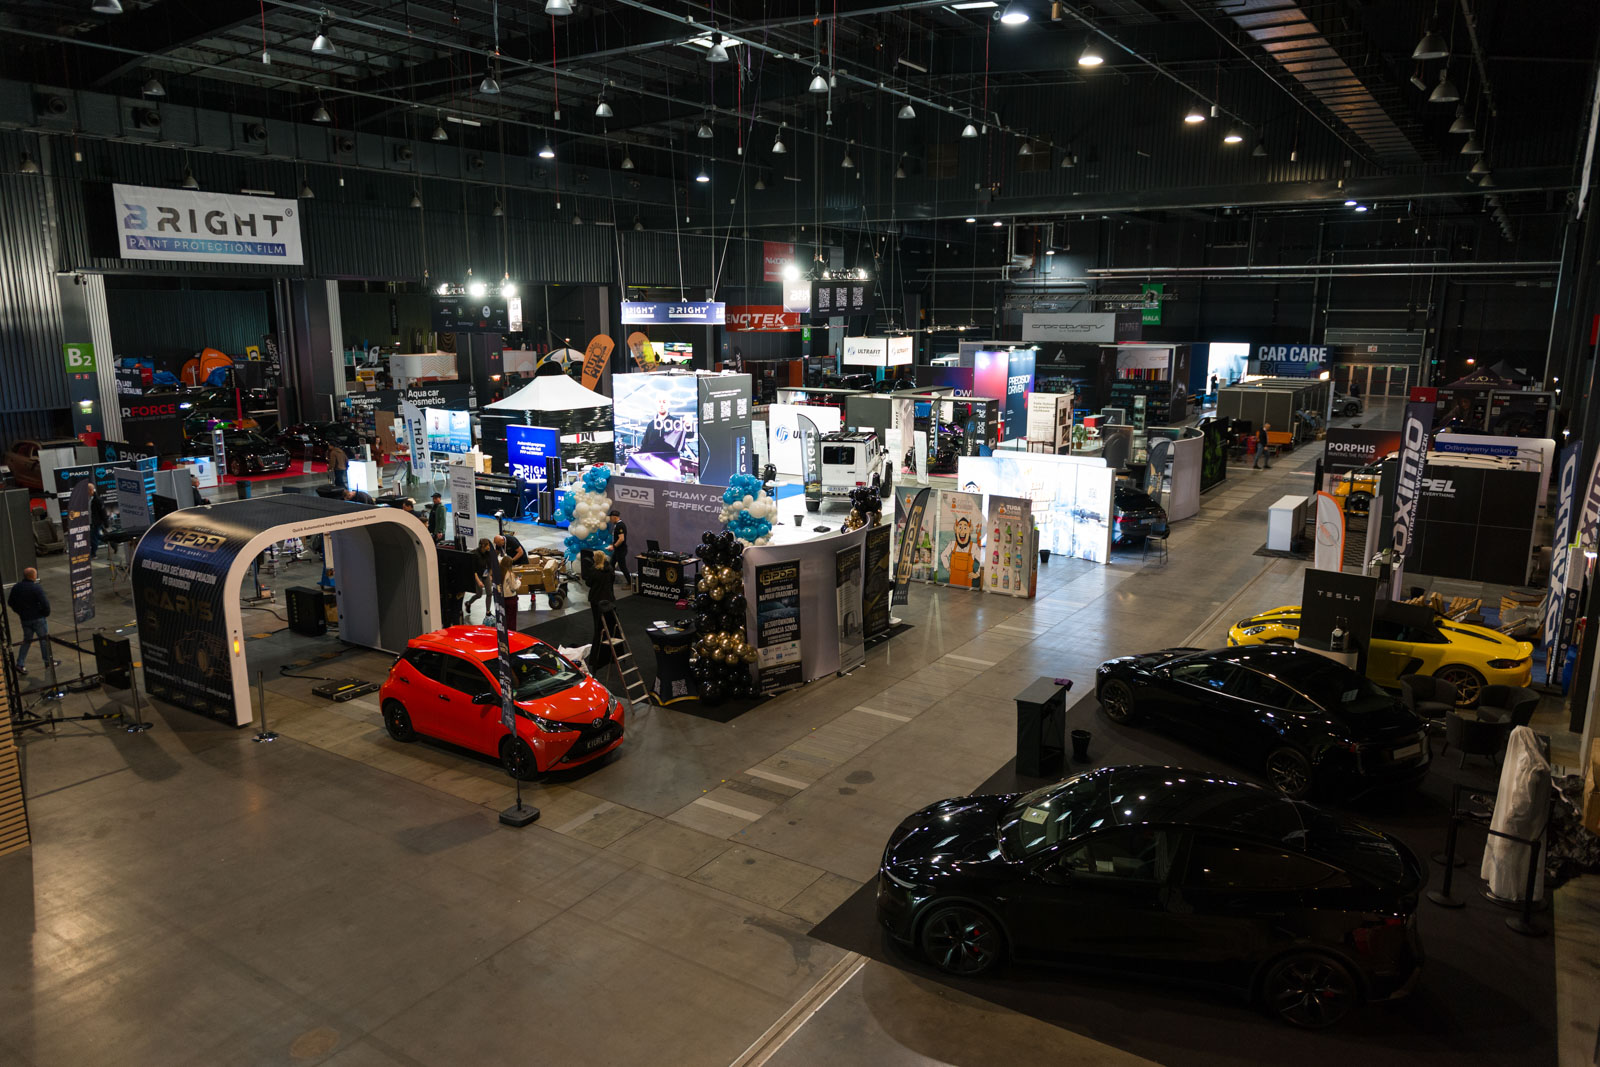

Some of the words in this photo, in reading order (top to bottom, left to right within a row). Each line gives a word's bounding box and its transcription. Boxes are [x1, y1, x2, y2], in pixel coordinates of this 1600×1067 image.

[124, 203, 284, 238] BRIGHT
[129, 239, 169, 250] PAINT
[174, 241, 252, 254] PROTECTION
[257, 245, 283, 255] FILM
[669, 306, 707, 314] BRIGHT
[67, 348, 93, 367] B2
[1258, 346, 1287, 362] CAR
[1290, 347, 1327, 363] CARE
[408, 390, 426, 400] Aqua
[1008, 384, 1025, 395] DRIVEN
[408, 397, 446, 405] cosmetics
[120, 404, 176, 418] RFORCE
[1328, 443, 1376, 453] PORPHIS
[1444, 443, 1488, 454] Odkrywamy
[1415, 433, 1429, 490] WYCIERACZKI
[524, 472, 542, 480] CUT
[121, 481, 138, 489] PDR
[1393, 416, 1423, 554] OXIMO
[620, 488, 649, 500] PDR
[662, 490, 707, 500] PCHAMY
[326, 518, 343, 527] Reporting
[347, 514, 364, 522] Inspection
[641, 582, 670, 591] PCHAMY
[1317, 590, 1360, 602] TESLA
